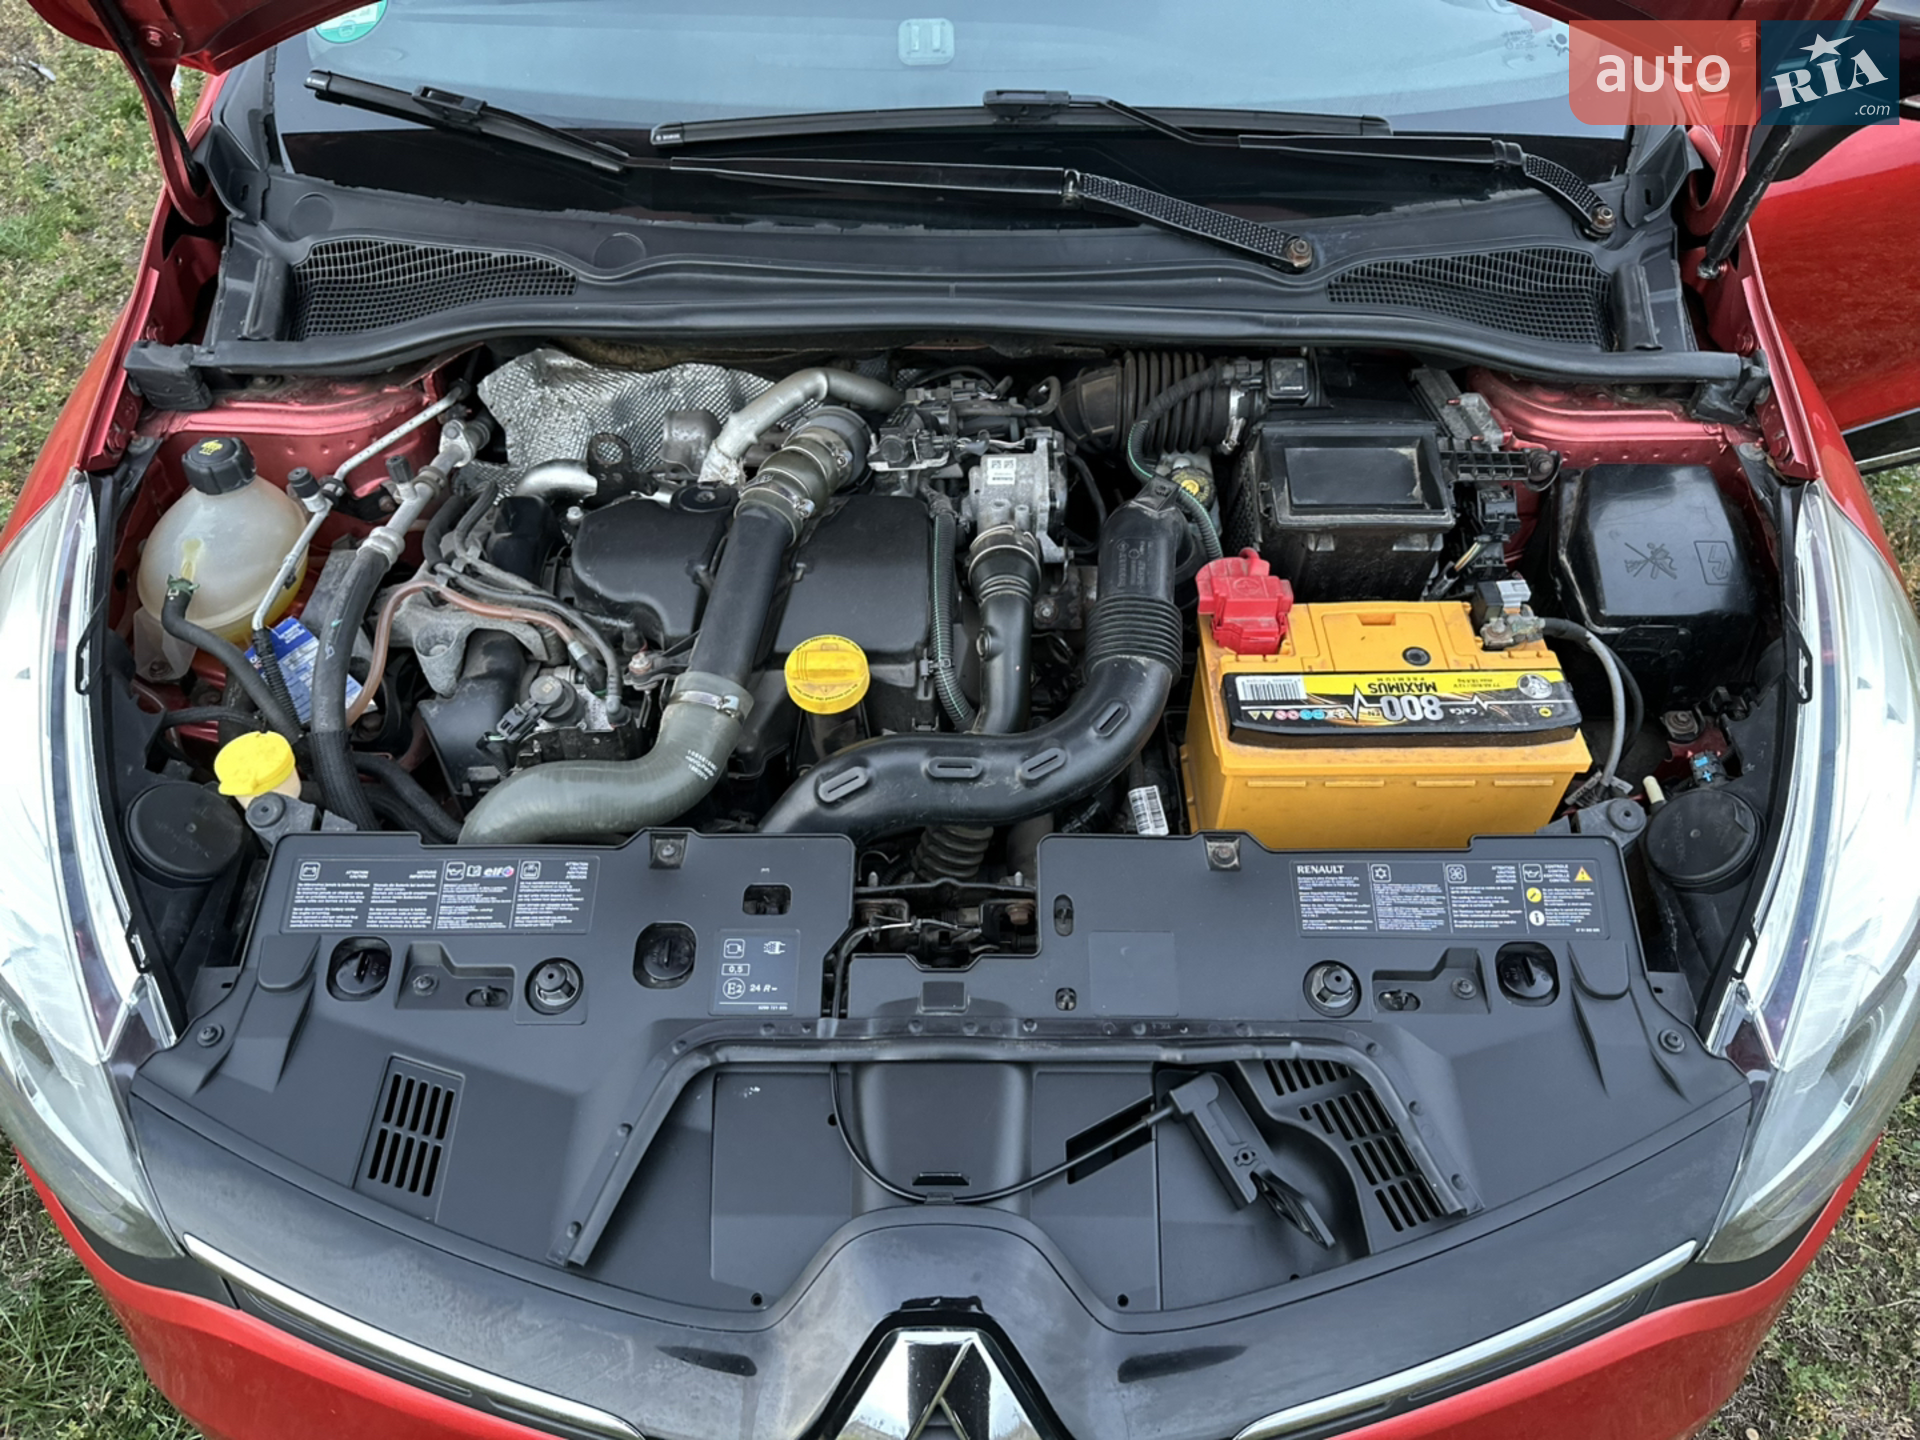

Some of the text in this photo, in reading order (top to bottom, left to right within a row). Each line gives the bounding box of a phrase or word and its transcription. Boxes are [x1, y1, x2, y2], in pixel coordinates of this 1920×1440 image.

[1366, 682, 1438, 695] MAXIMUS
[1381, 695, 1445, 721] 800
[1296, 864, 1345, 875] RENAULT
[728, 965, 743, 974] 0,5
[727, 982, 742, 995] E2
[749, 984, 761, 993] 24
